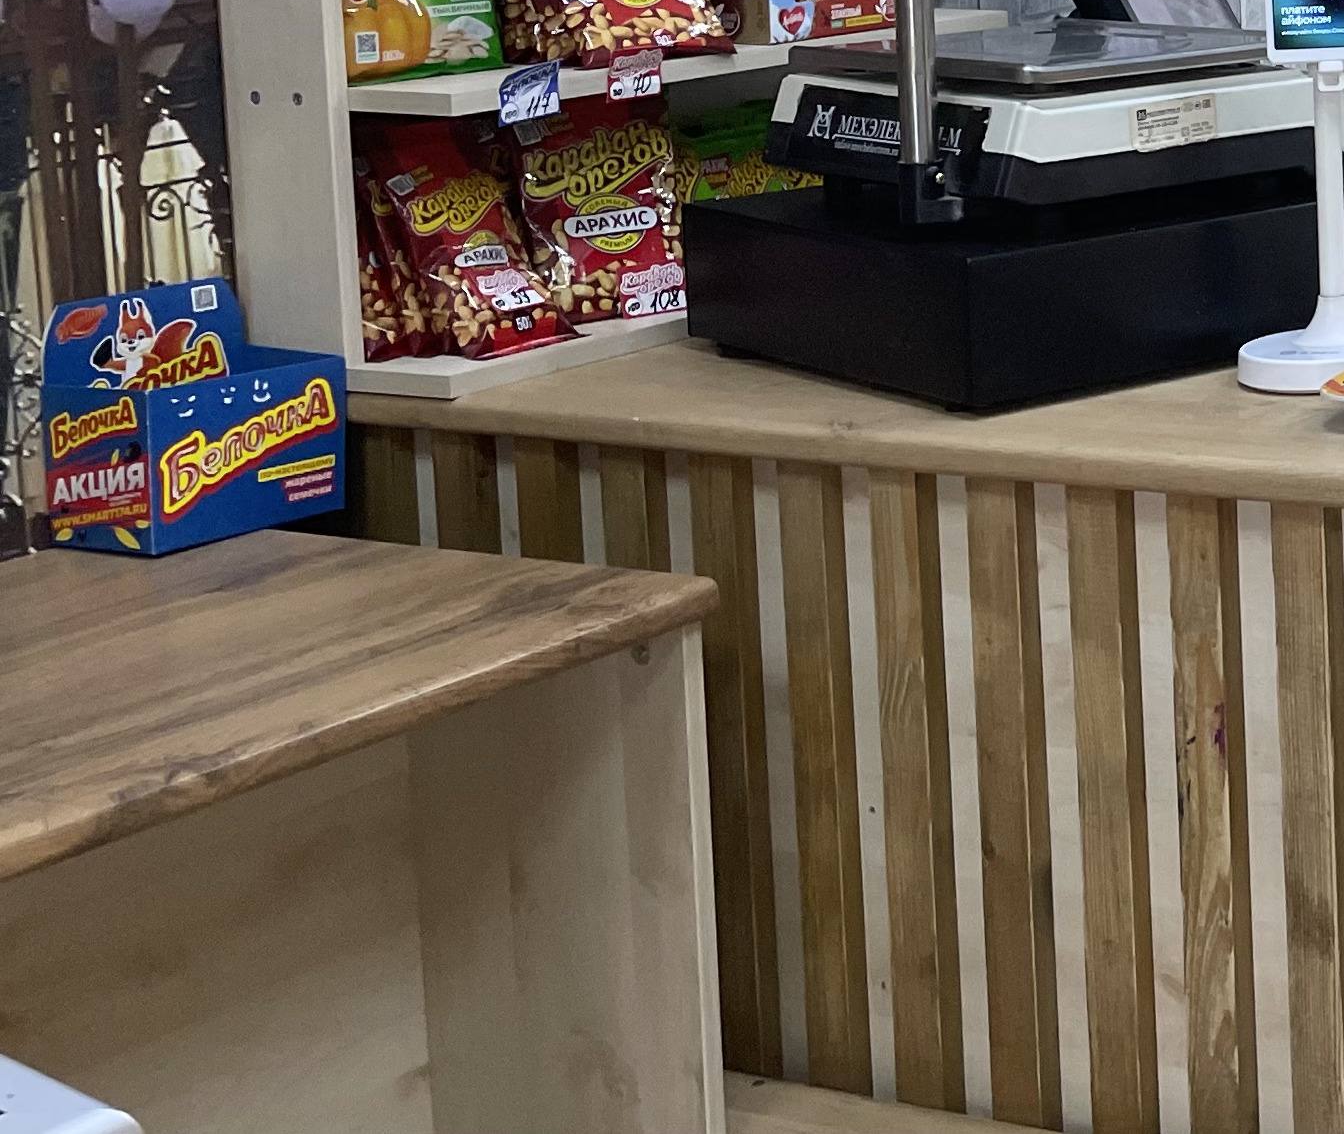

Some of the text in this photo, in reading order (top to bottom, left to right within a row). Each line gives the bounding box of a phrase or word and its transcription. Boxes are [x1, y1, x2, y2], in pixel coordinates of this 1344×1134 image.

[1280, 5, 1326, 15] платите
[1281, 15, 1332, 26] айфоном
[526, 121, 650, 180] Караван
[568, 129, 669, 197] орехов
[573, 212, 651, 234] АРАХИС
[51, 400, 136, 454] БелочкА
[165, 384, 333, 508] БелочкА
[53, 461, 146, 505] АКЦИЯ
